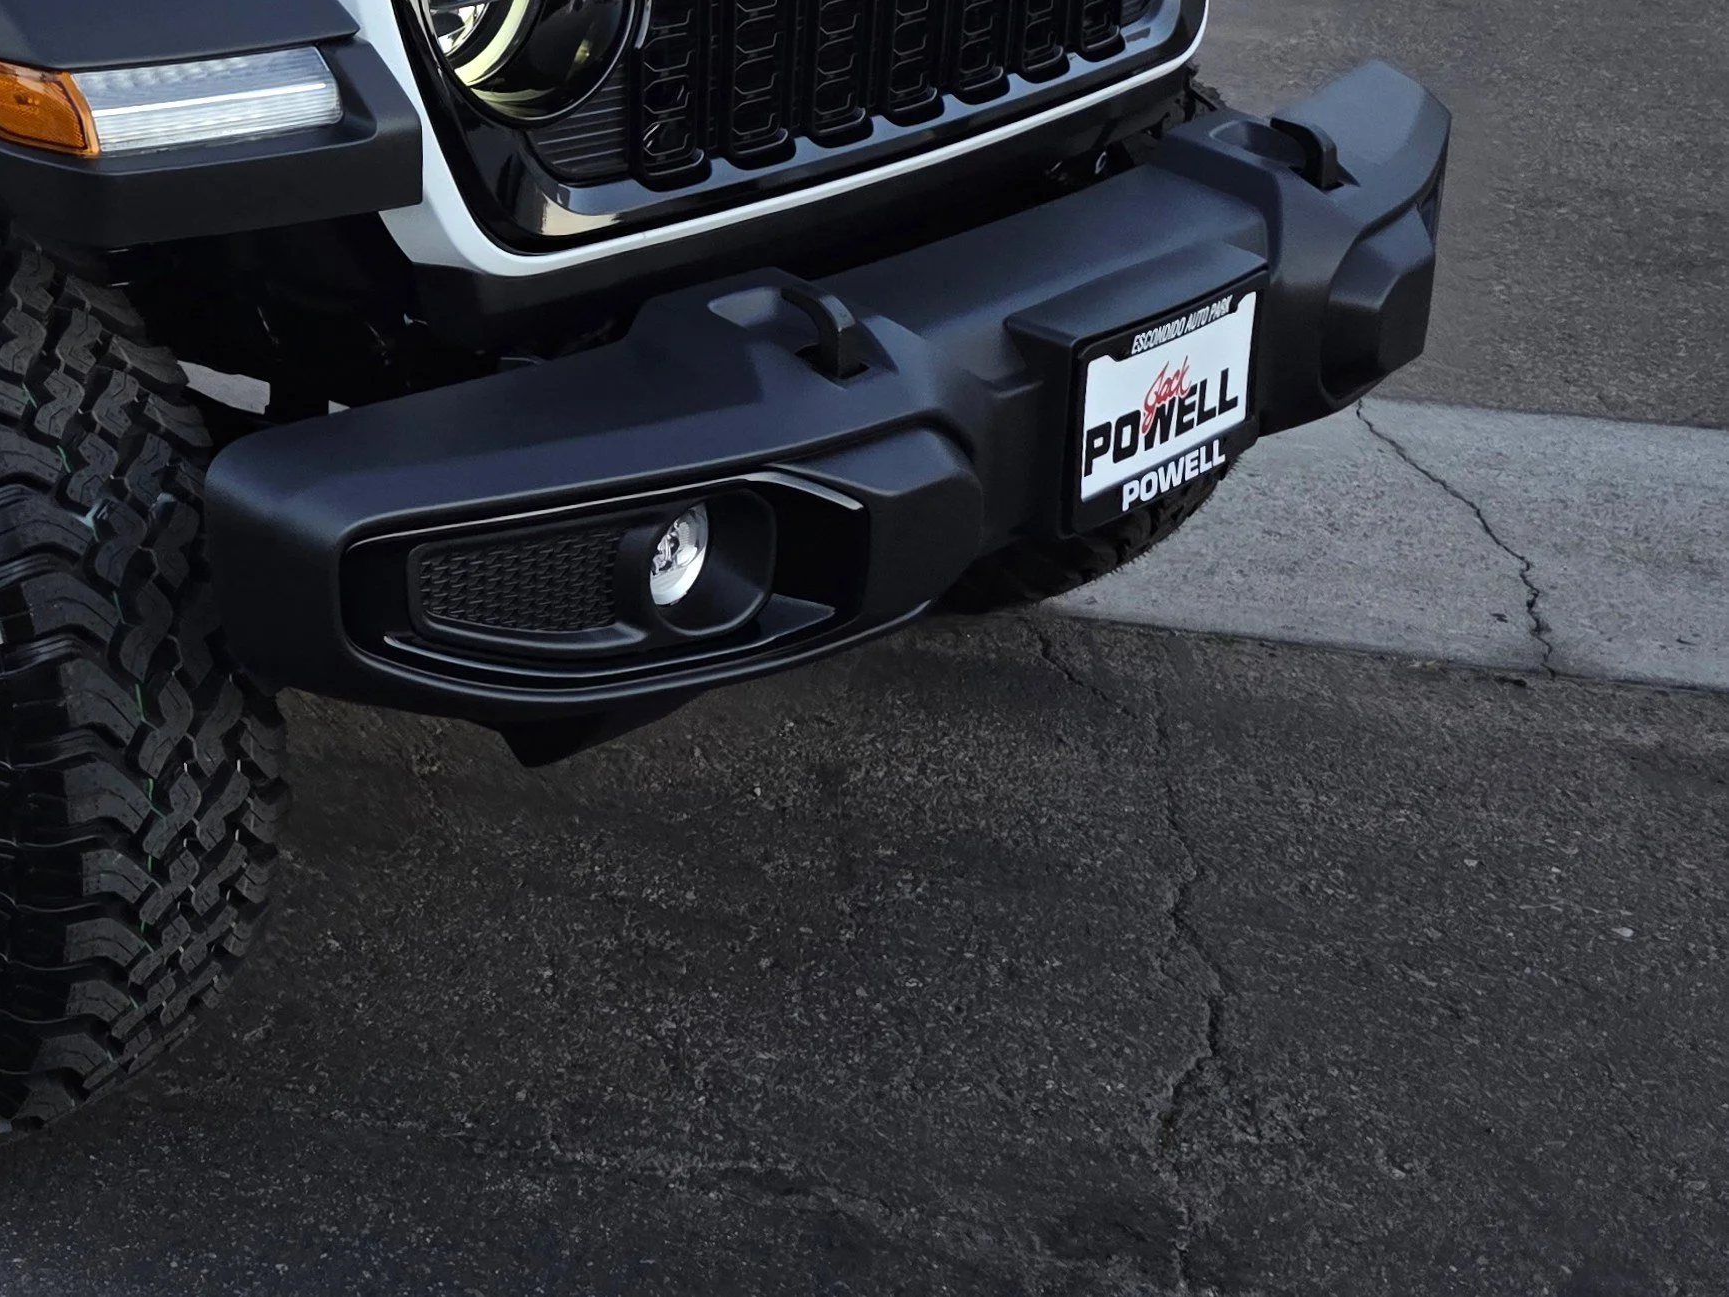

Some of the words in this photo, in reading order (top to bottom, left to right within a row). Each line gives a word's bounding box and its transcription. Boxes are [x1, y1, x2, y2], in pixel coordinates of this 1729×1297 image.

[1131, 316, 1186, 355] ESCONDIDO
[1184, 306, 1210, 333] AUTO
[1207, 294, 1233, 323] PARK
[1084, 368, 1238, 477] POWELL
[1122, 439, 1225, 512] POWELL
